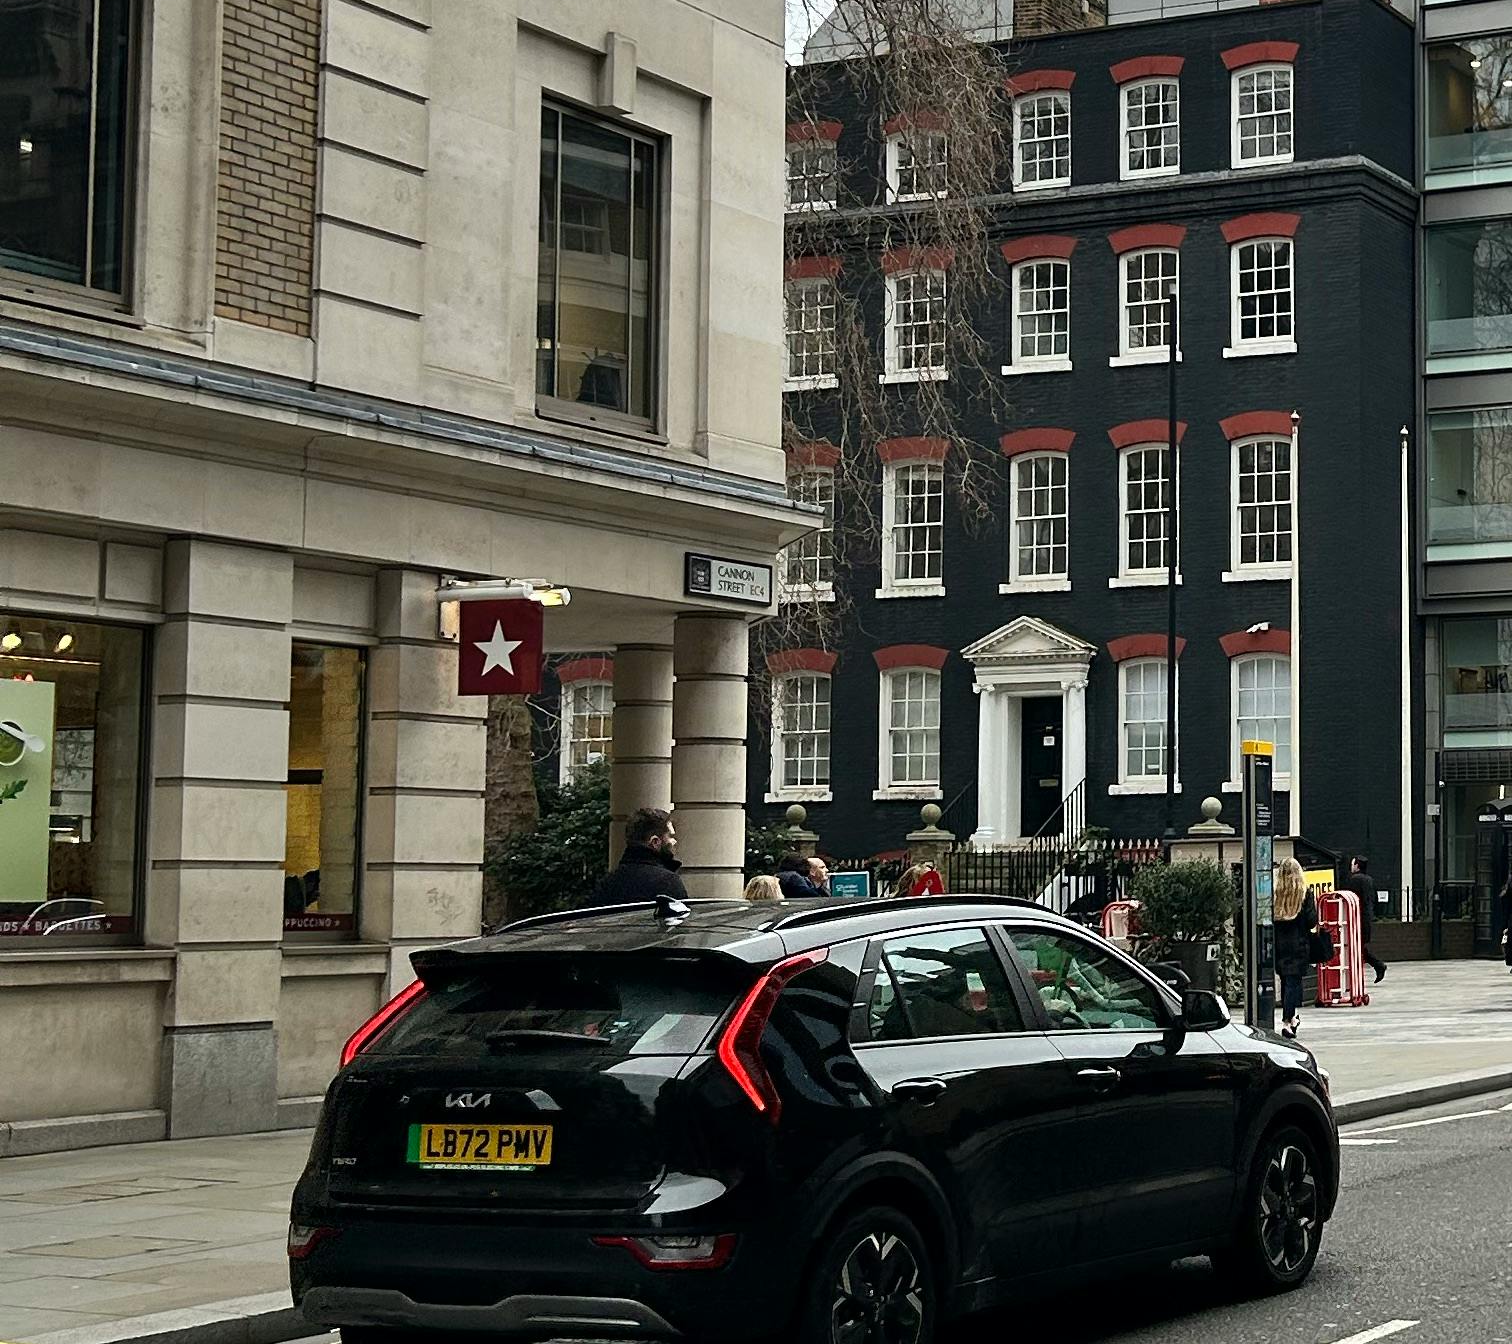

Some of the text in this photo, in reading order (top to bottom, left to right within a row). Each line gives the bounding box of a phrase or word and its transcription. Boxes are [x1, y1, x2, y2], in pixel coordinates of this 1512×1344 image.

[718, 566, 755, 581] CANNON
[718, 580, 765, 597] STREET EC4
[445, 1092, 492, 1108] KIA
[426, 1128, 548, 1159] LB72 PMV
